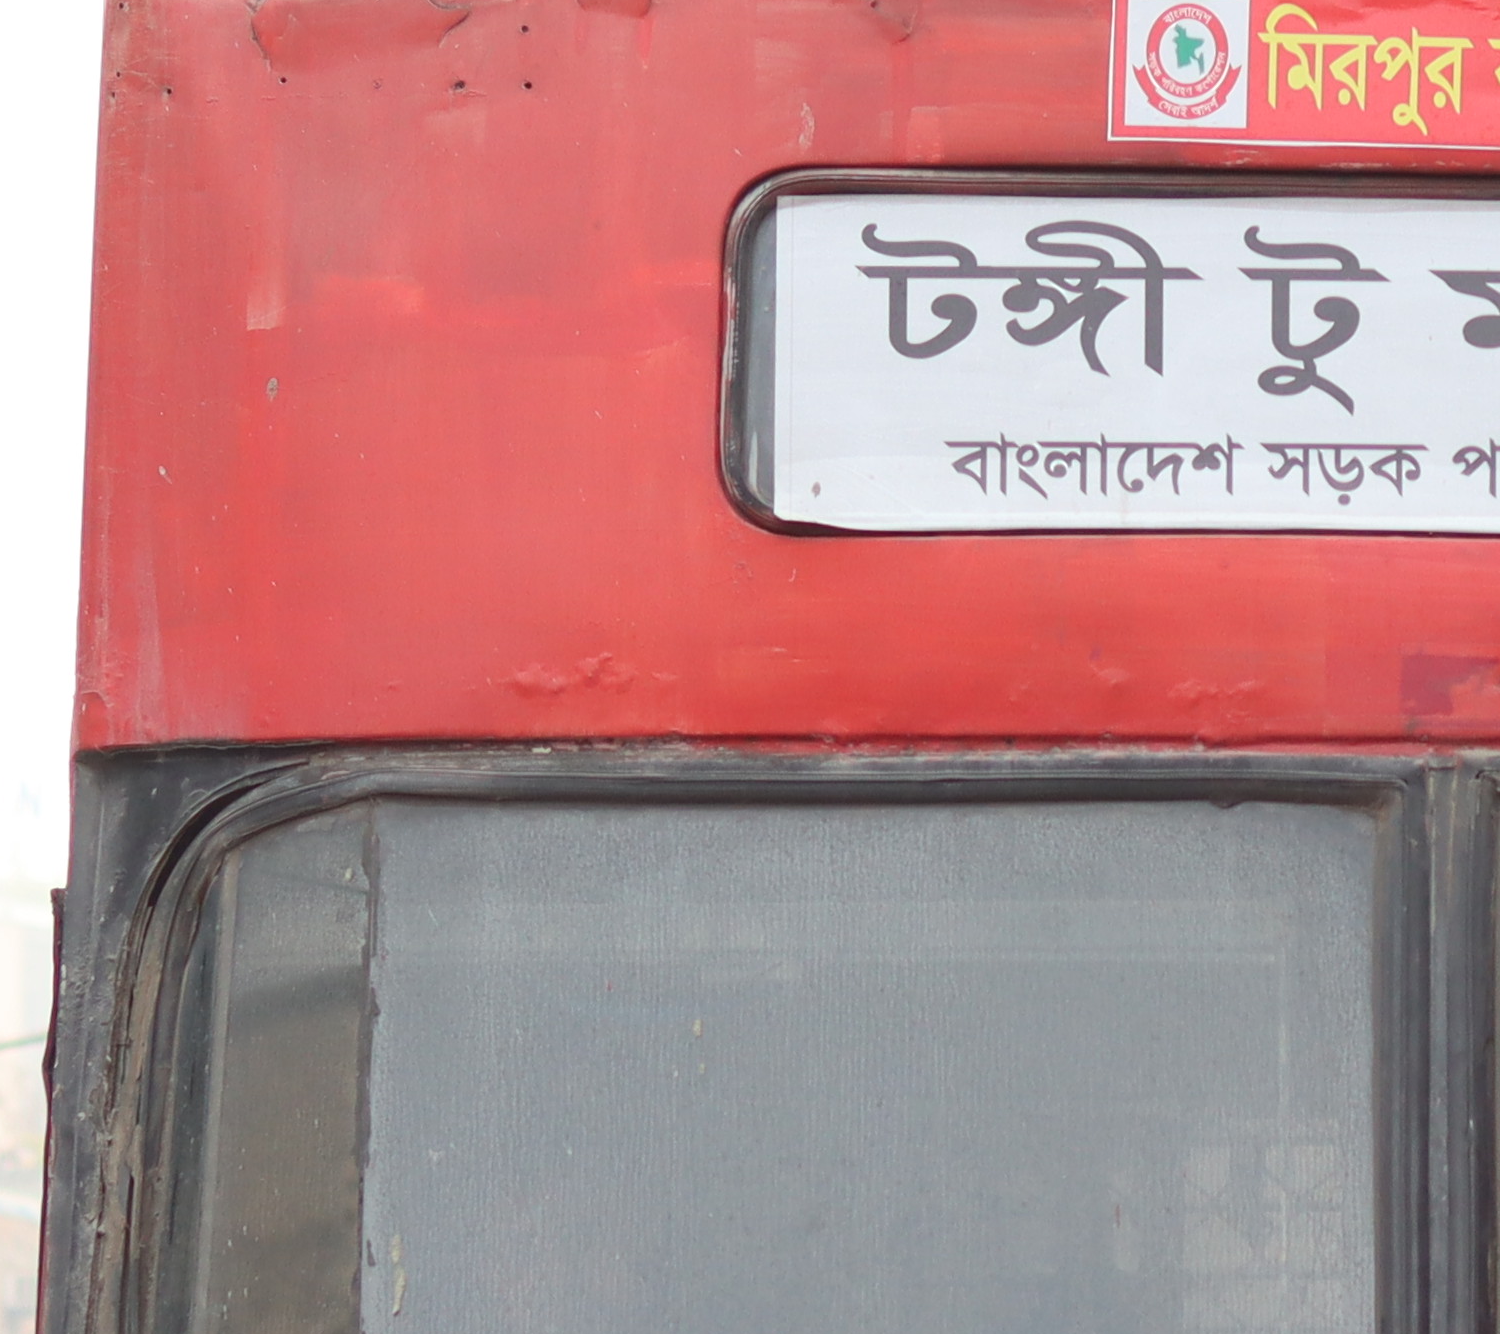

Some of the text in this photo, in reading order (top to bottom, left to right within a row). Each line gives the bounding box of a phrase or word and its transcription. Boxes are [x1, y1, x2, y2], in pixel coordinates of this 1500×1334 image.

[1163, 7, 1212, 24] বাংলাদেশ
[1258, 3, 1474, 137] মিরপুর
[855, 219, 1200, 377] টঙ্গী
[1241, 225, 1391, 415] টু
[943, 432, 1246, 501] বাংলাদেশ
[1260, 441, 1431, 506] সড়ক
